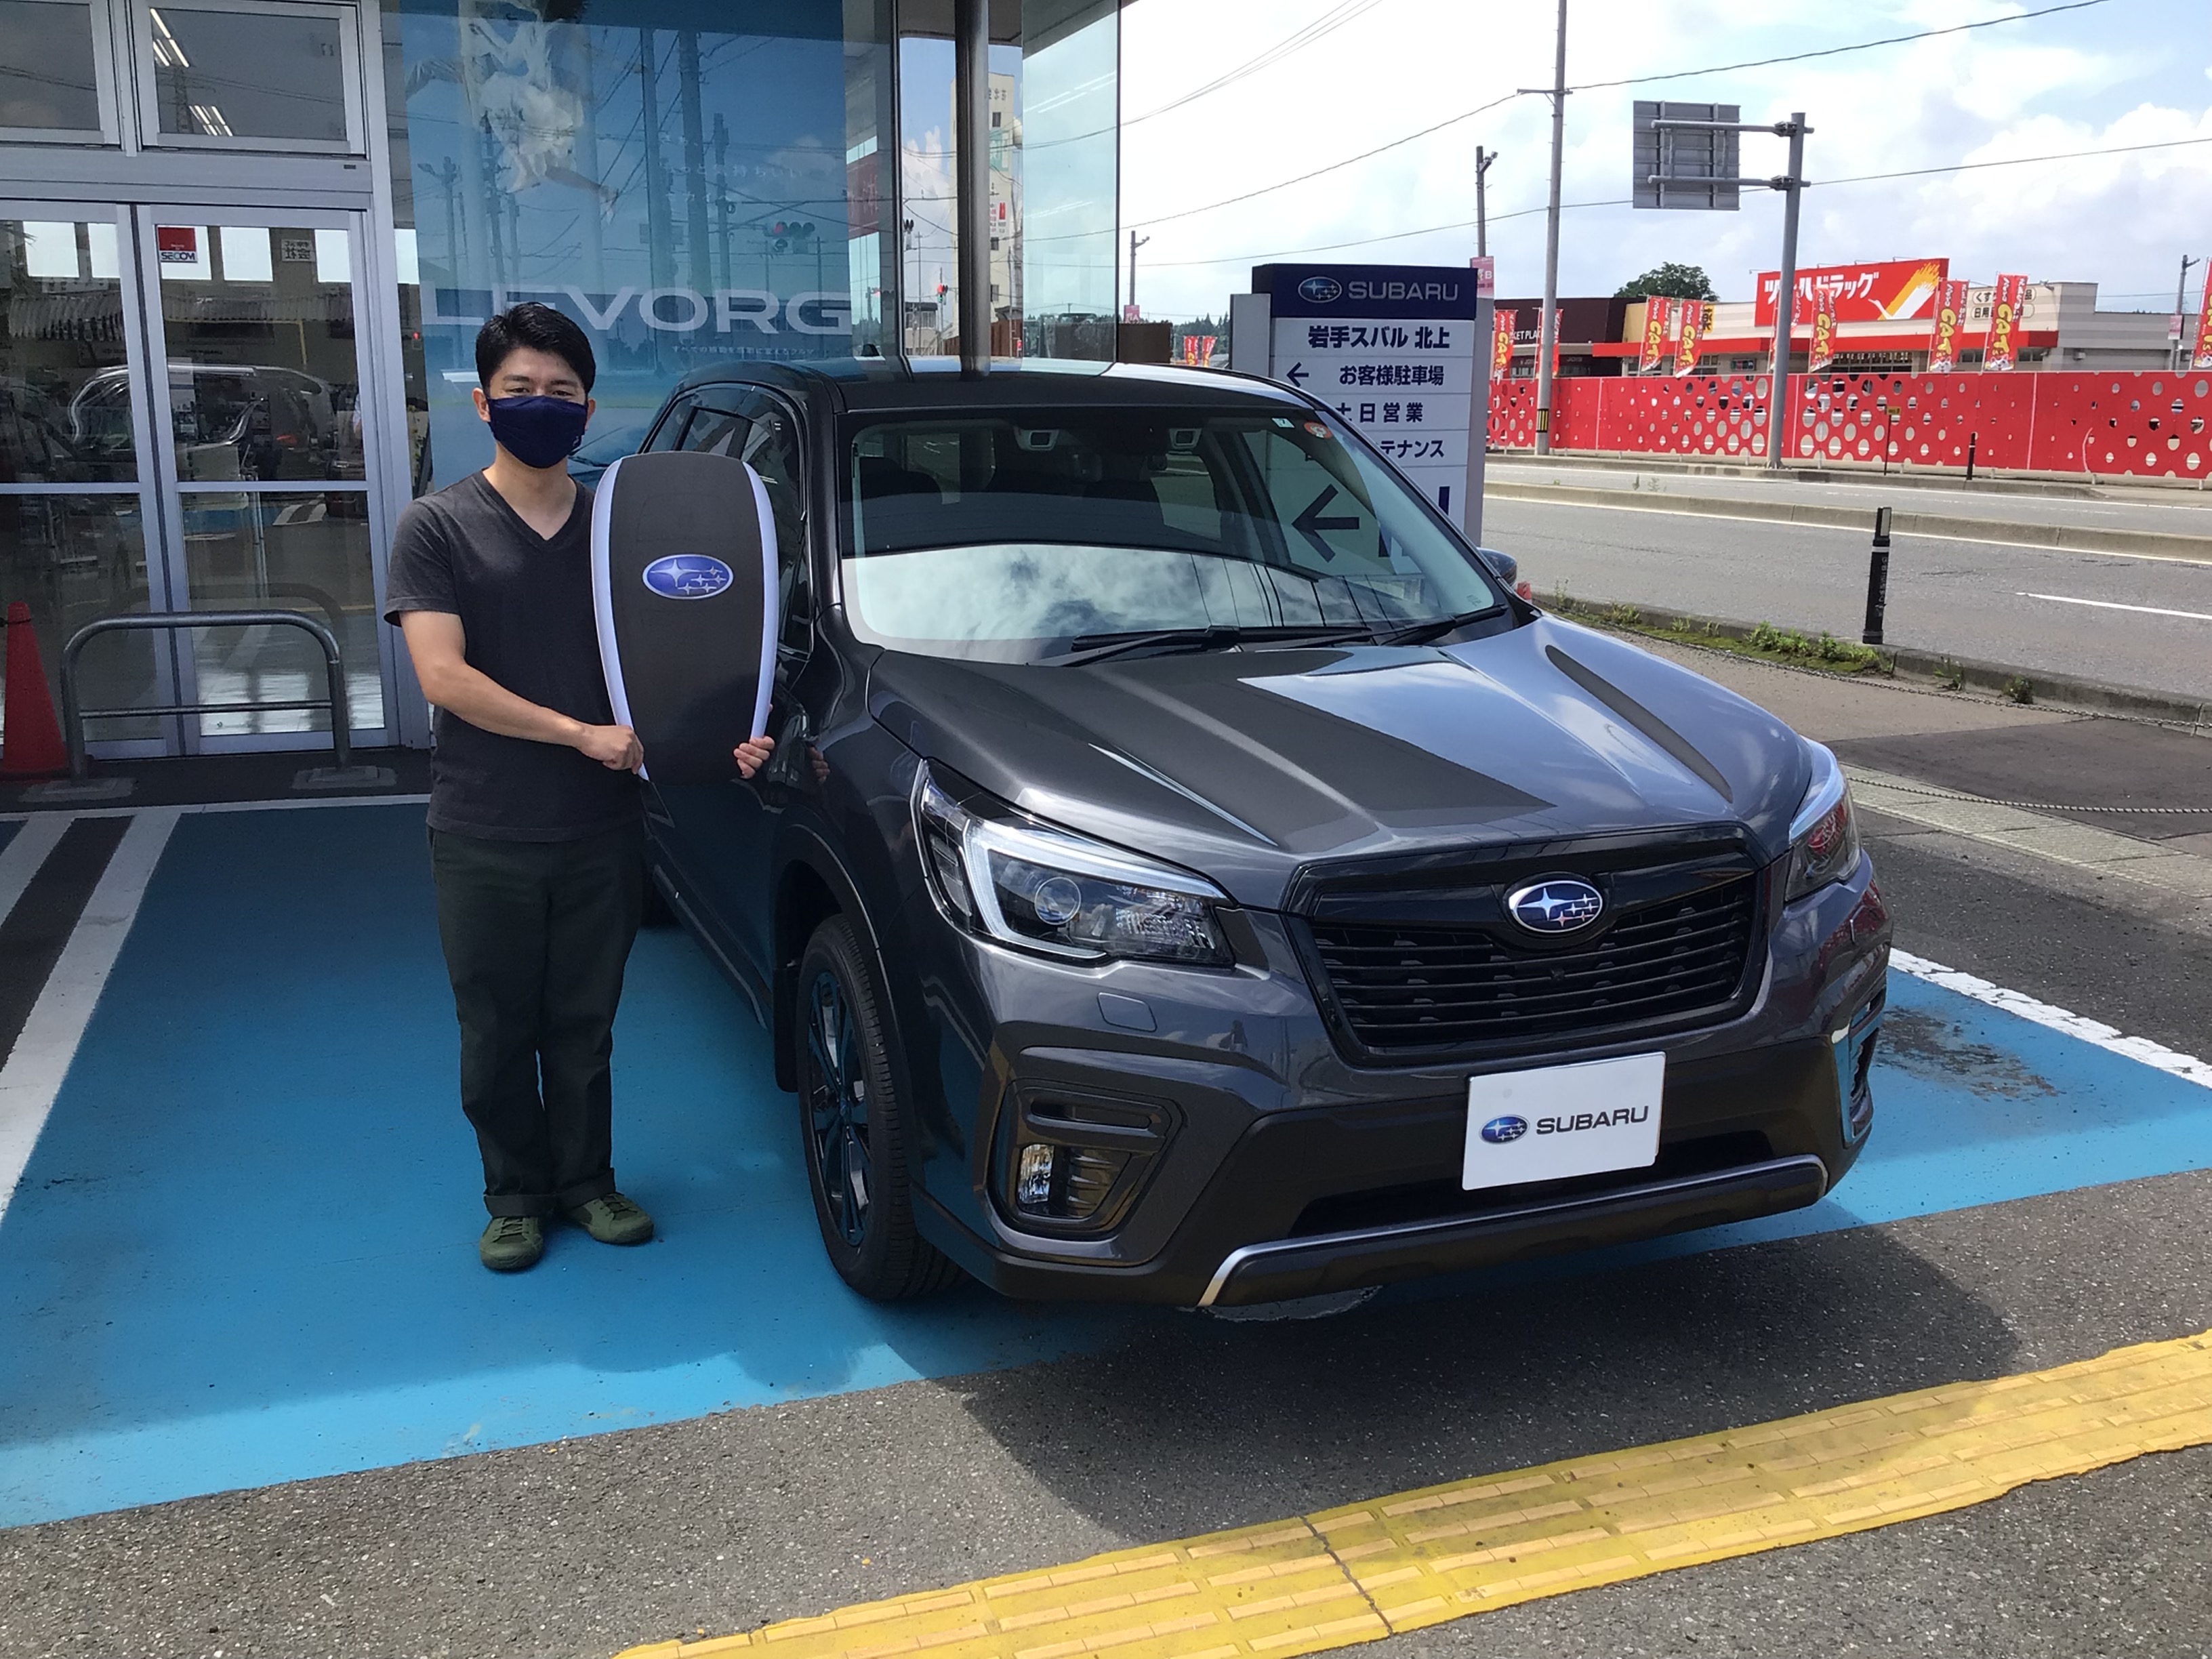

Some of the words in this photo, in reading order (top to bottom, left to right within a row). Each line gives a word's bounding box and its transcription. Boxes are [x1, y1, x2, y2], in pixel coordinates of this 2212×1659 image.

[161, 251, 195, 260] SECOM
[1348, 281, 1458, 301] SUBARU
[1764, 272, 1880, 304] ツハドラッグ
[1308, 325, 1408, 349] 岩手スバル
[1415, 326, 1450, 349] 北上
[1339, 365, 1444, 386] お客様駐車場
[1335, 402, 1423, 423] 土日営業
[1379, 439, 1444, 458] テナンス
[1536, 1105, 1649, 1135] SUBARU
